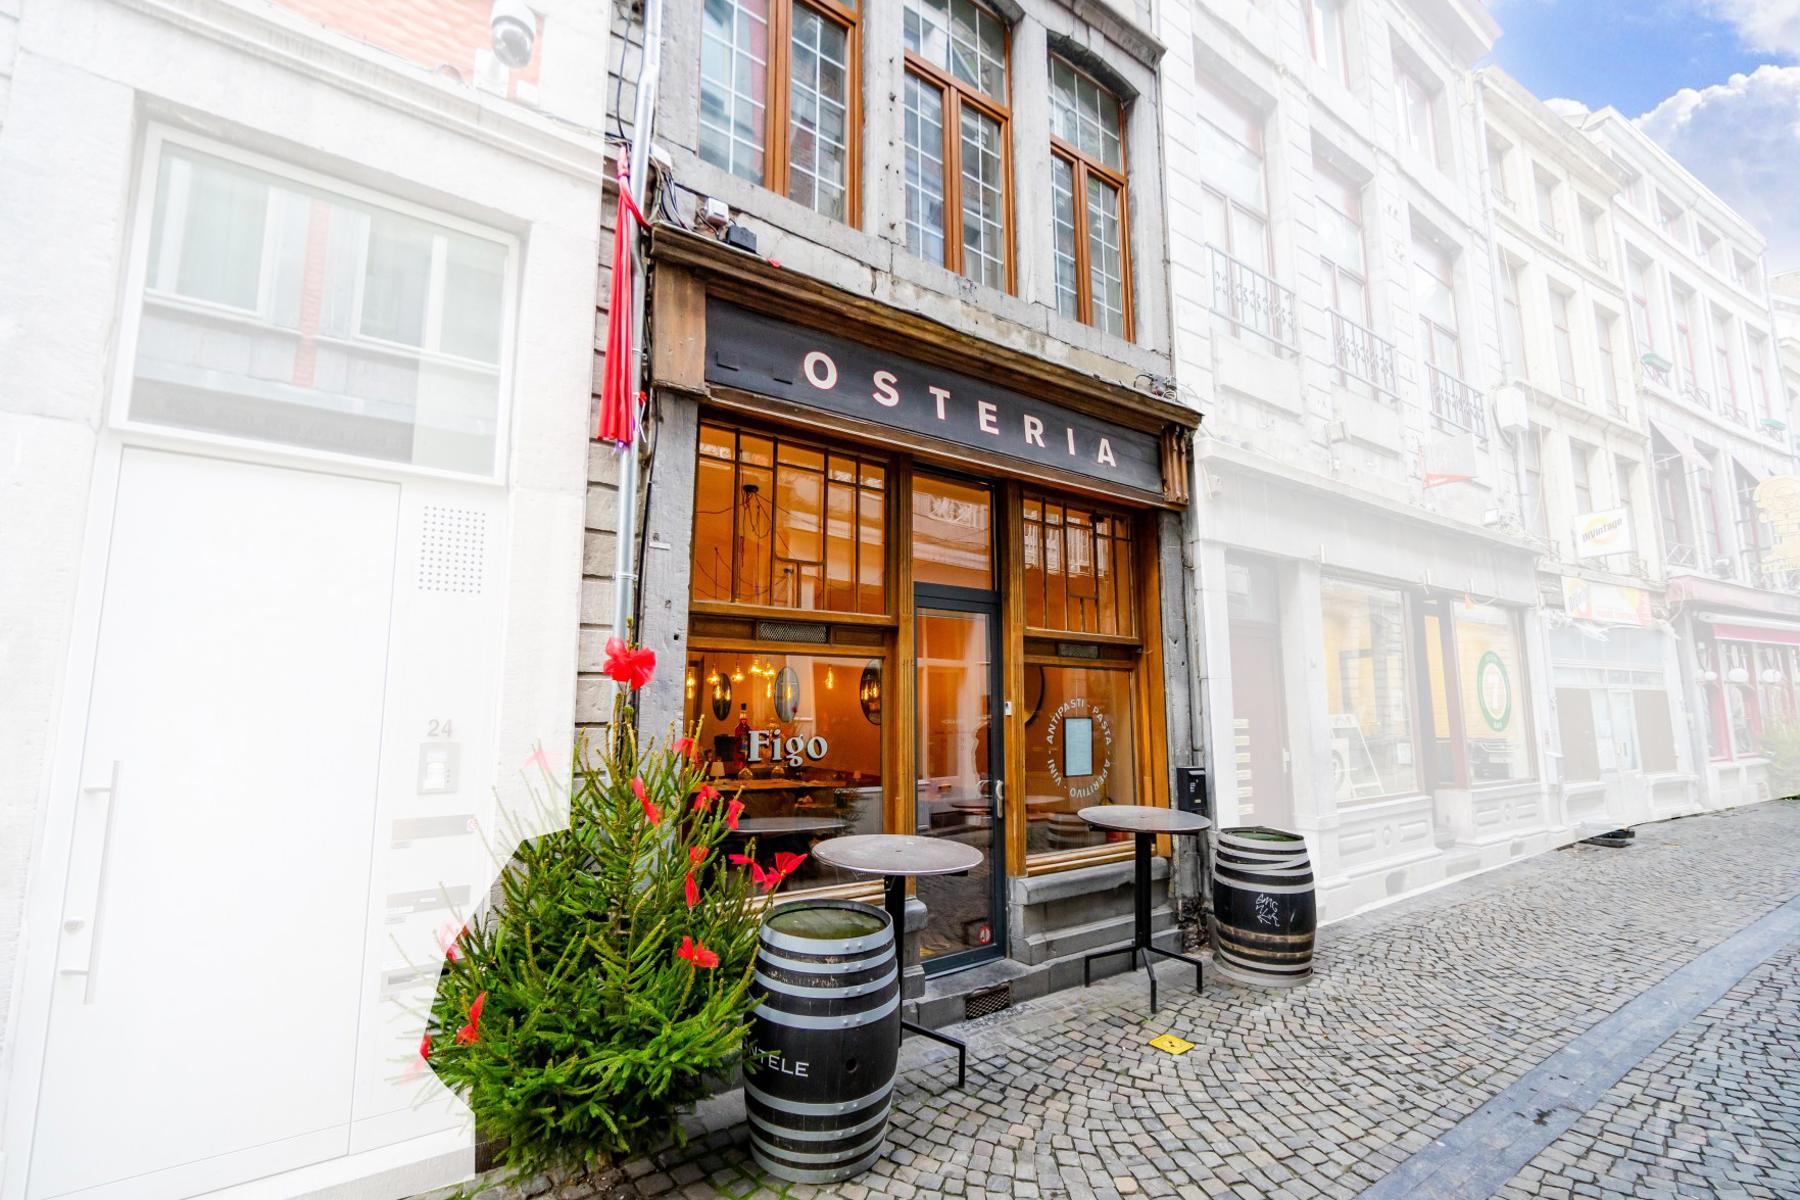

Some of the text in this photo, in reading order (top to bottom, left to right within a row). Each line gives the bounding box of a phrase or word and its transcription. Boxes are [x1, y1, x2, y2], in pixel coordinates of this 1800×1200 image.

[803, 351, 1117, 468] OSTERIA
[427, 718, 453, 737] 24
[748, 728, 828, 767] Figo
[1046, 698, 1112, 798] ANTIPASTI PASTA APERITIVO VINI
